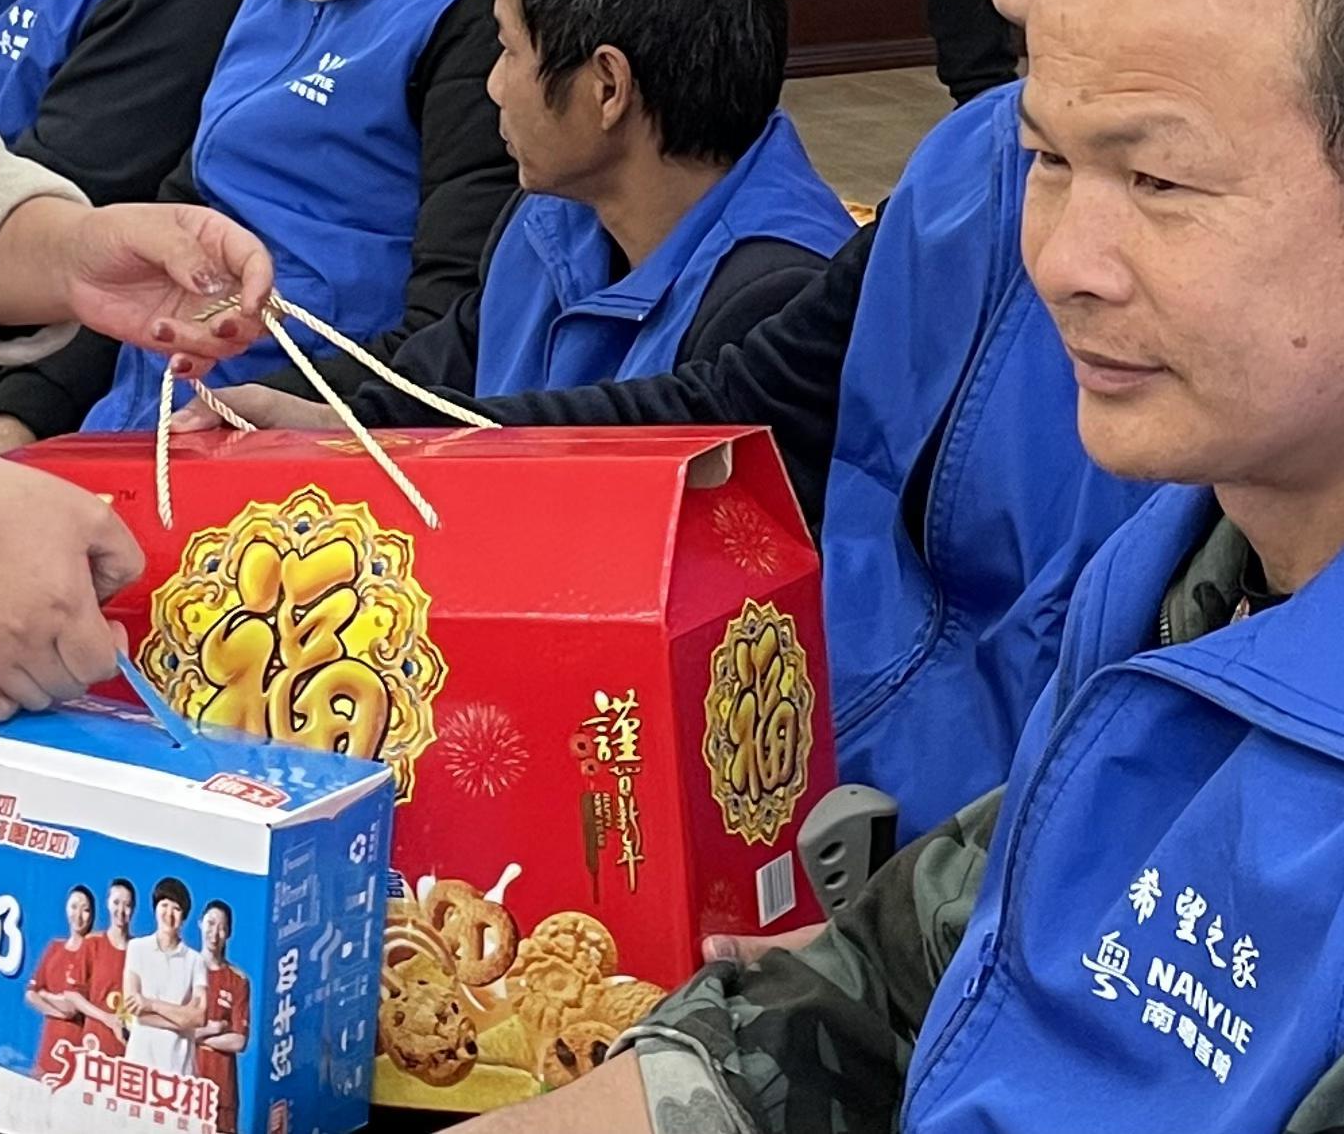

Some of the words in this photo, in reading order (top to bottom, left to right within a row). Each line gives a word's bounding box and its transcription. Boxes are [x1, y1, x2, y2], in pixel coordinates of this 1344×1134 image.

[1147, 956, 1254, 1054] NANYUE
[83, 1054, 217, 1122] 中国女排
